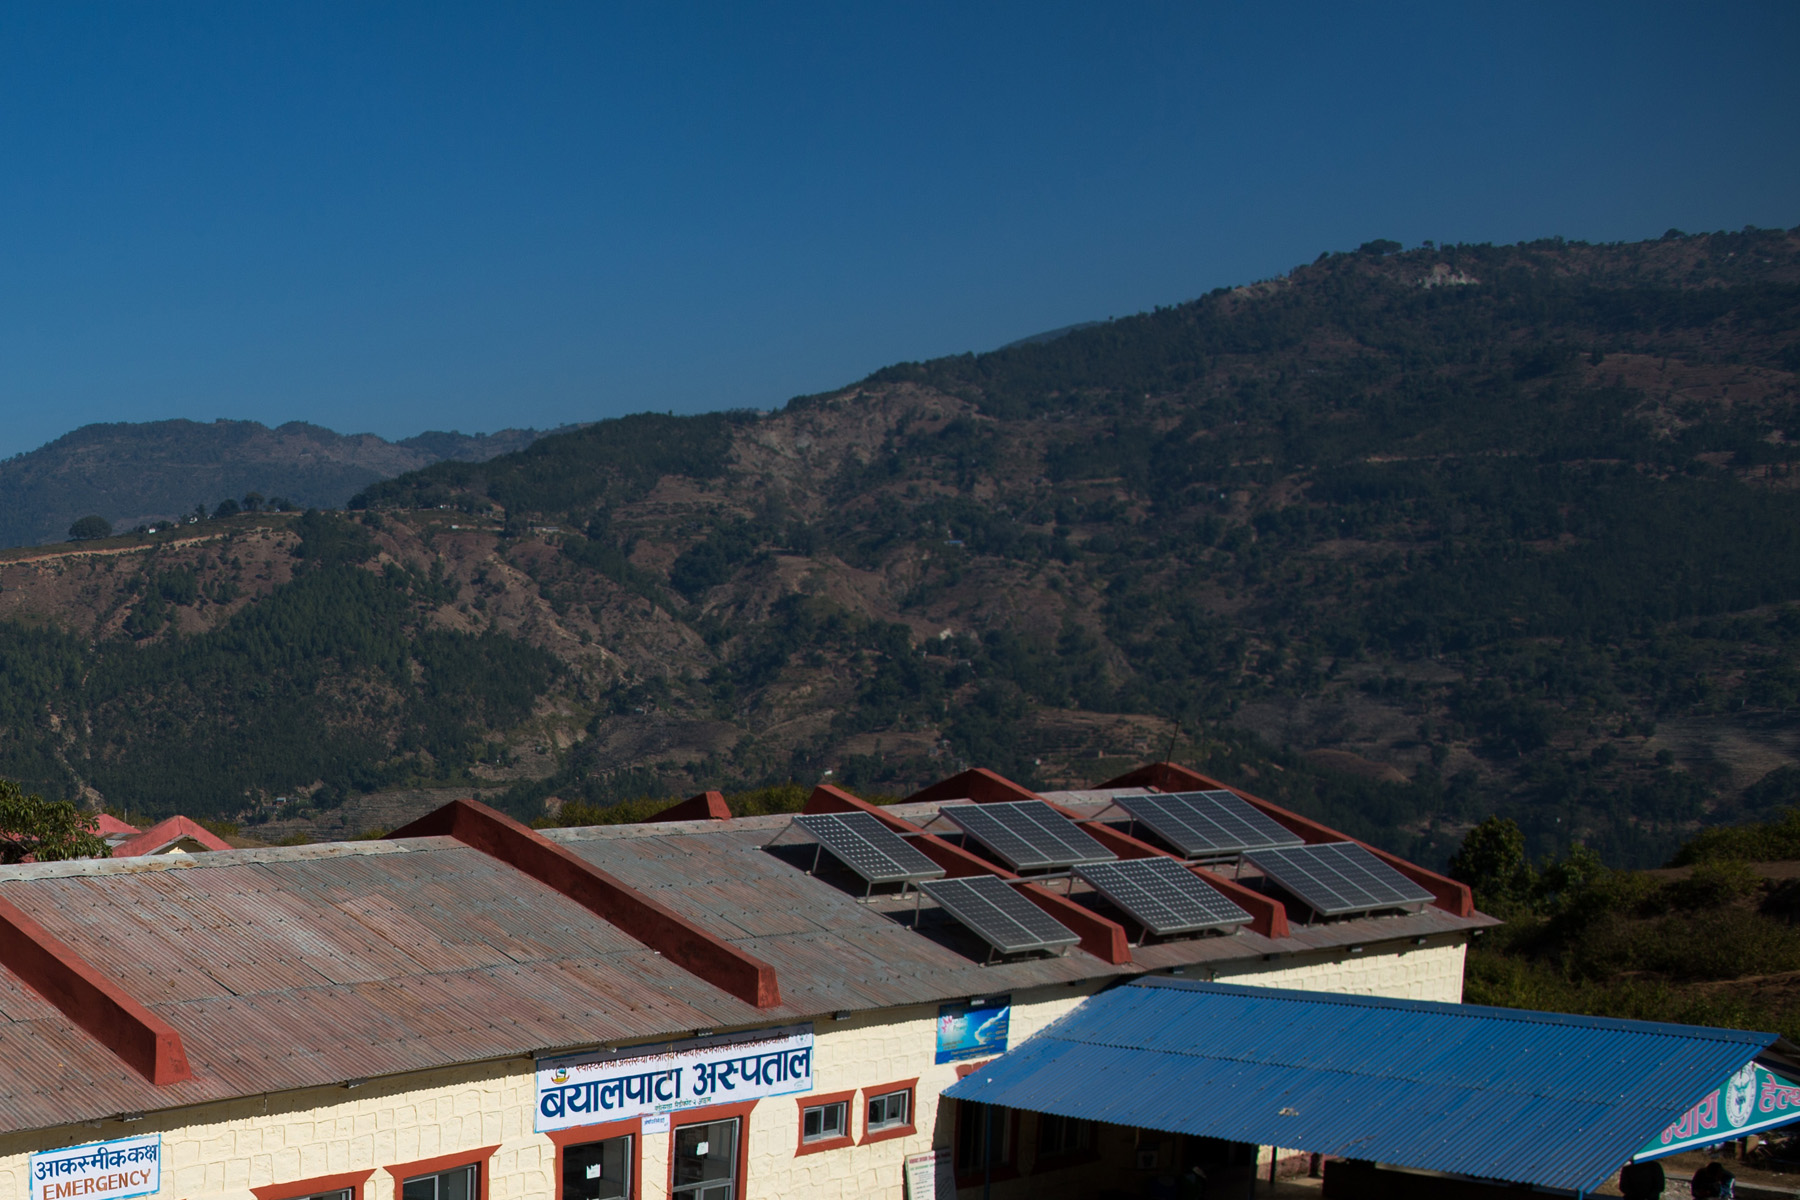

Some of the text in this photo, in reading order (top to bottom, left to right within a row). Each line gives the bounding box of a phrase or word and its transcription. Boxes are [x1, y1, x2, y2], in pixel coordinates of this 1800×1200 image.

[541, 1045, 812, 1118] बयालपाटा अस्पताल
[128, 1144, 158, 1163] कक्ष
[43, 1168, 151, 1200] EMERGENCY
